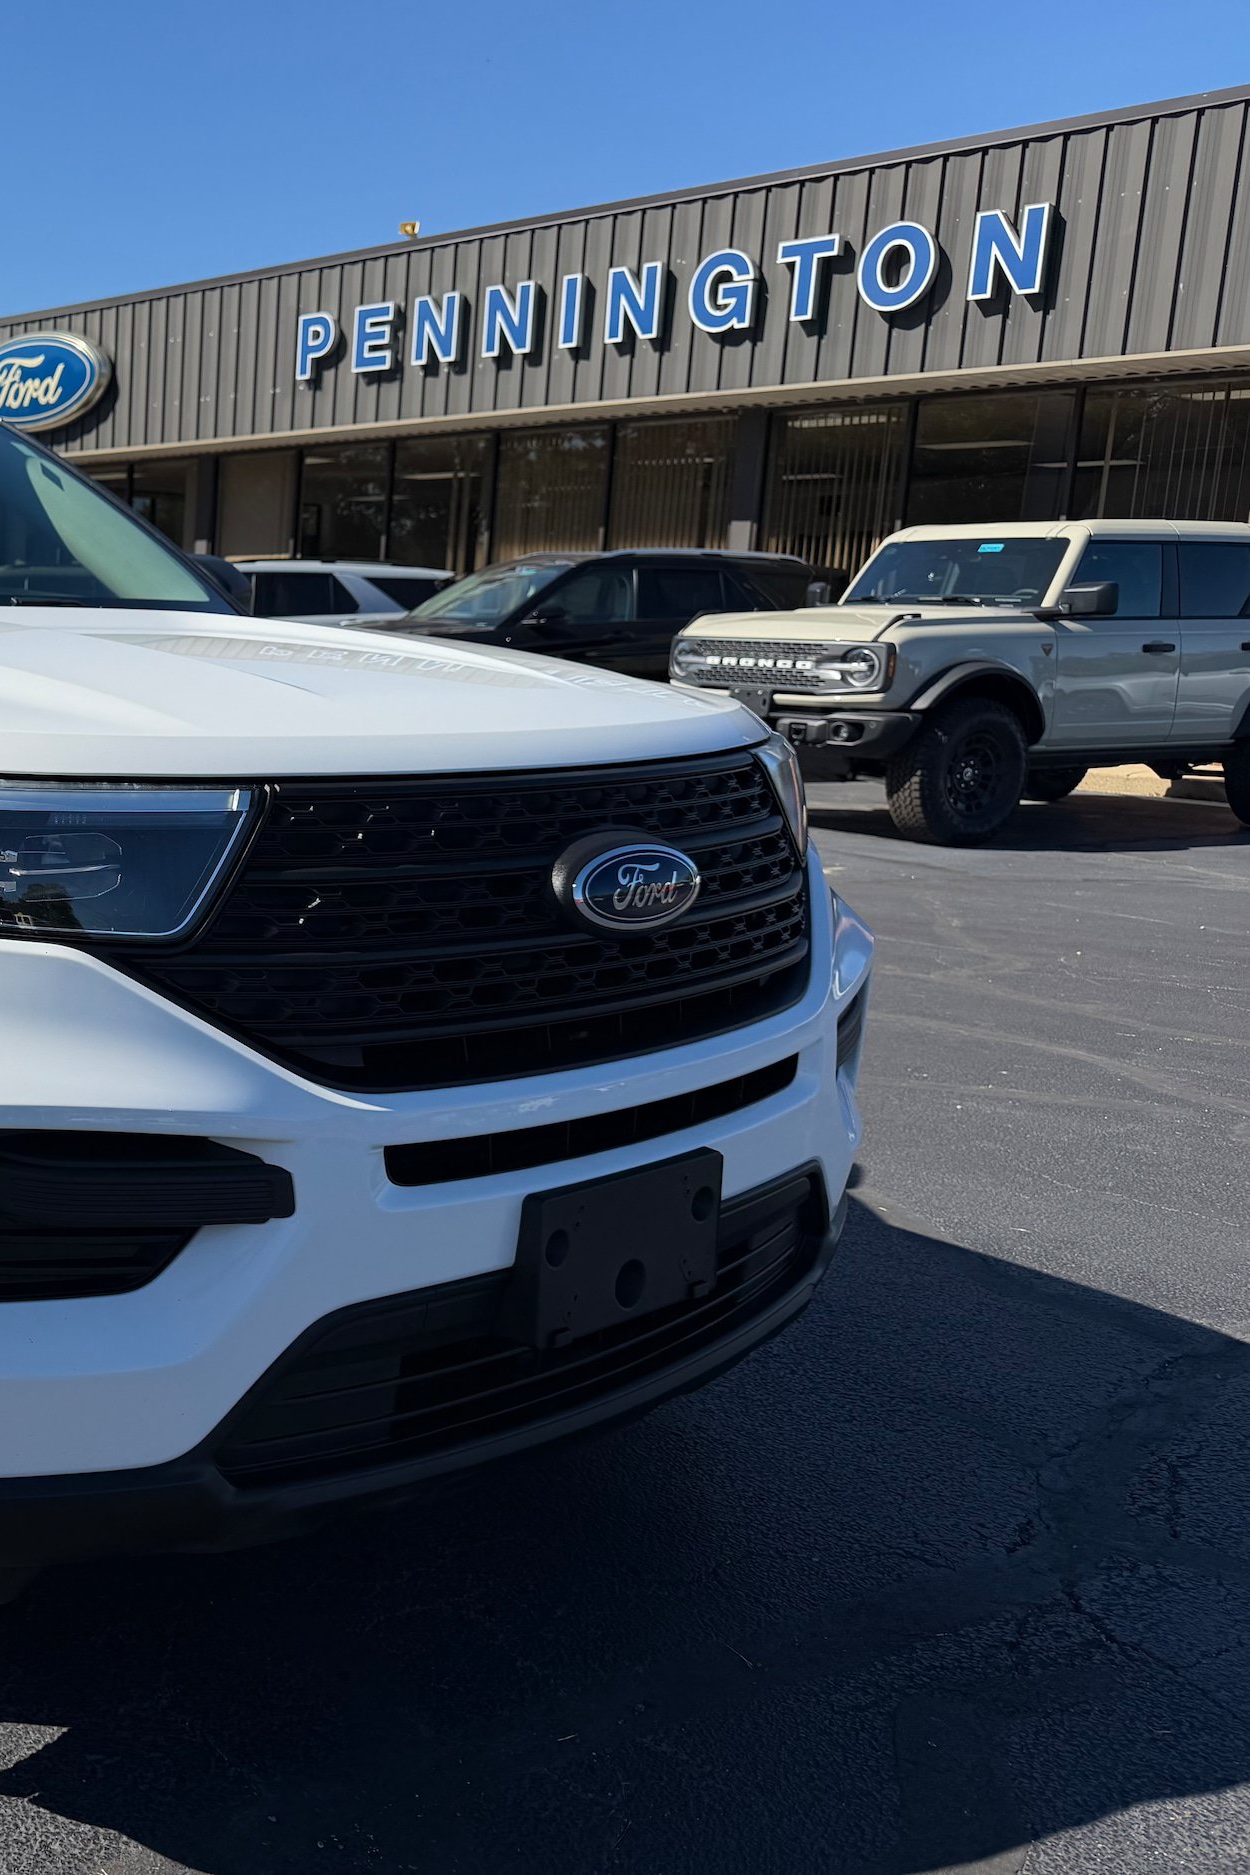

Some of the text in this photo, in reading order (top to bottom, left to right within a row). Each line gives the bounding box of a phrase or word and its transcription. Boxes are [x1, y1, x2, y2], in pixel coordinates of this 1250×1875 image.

[295, 202, 1053, 380] PENNINGTON
[706, 655, 815, 670] BRONCO
[613, 863, 678, 910] Ford
